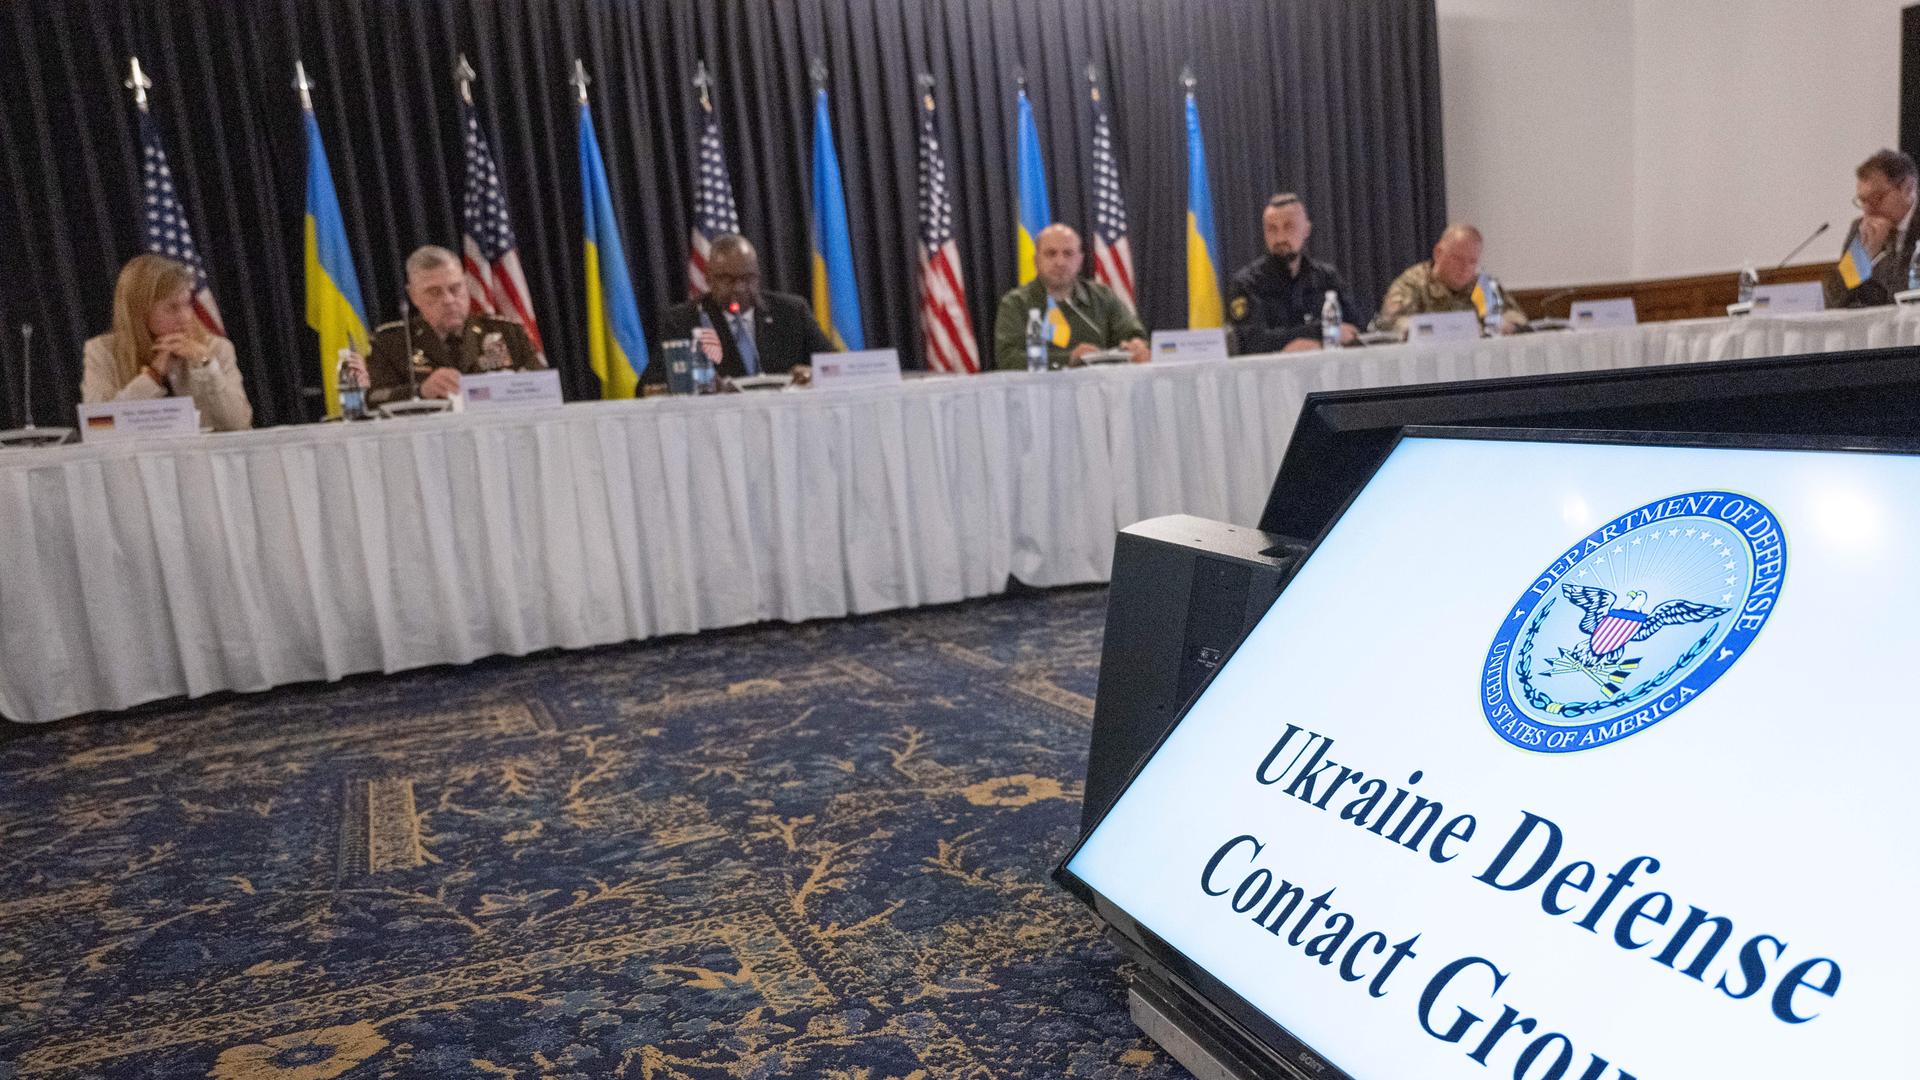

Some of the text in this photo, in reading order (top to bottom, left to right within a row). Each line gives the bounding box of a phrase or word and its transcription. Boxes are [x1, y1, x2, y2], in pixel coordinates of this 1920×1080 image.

[1529, 495, 1782, 631] DEPARTMENT OF DEFENSE
[1486, 639, 1698, 748] UNITED STATES OF AMERICA
[1200, 834, 1422, 999] Contact
[1255, 722, 1842, 1025] Ukraine Defense
[1299, 1052, 1325, 1073] SONY
